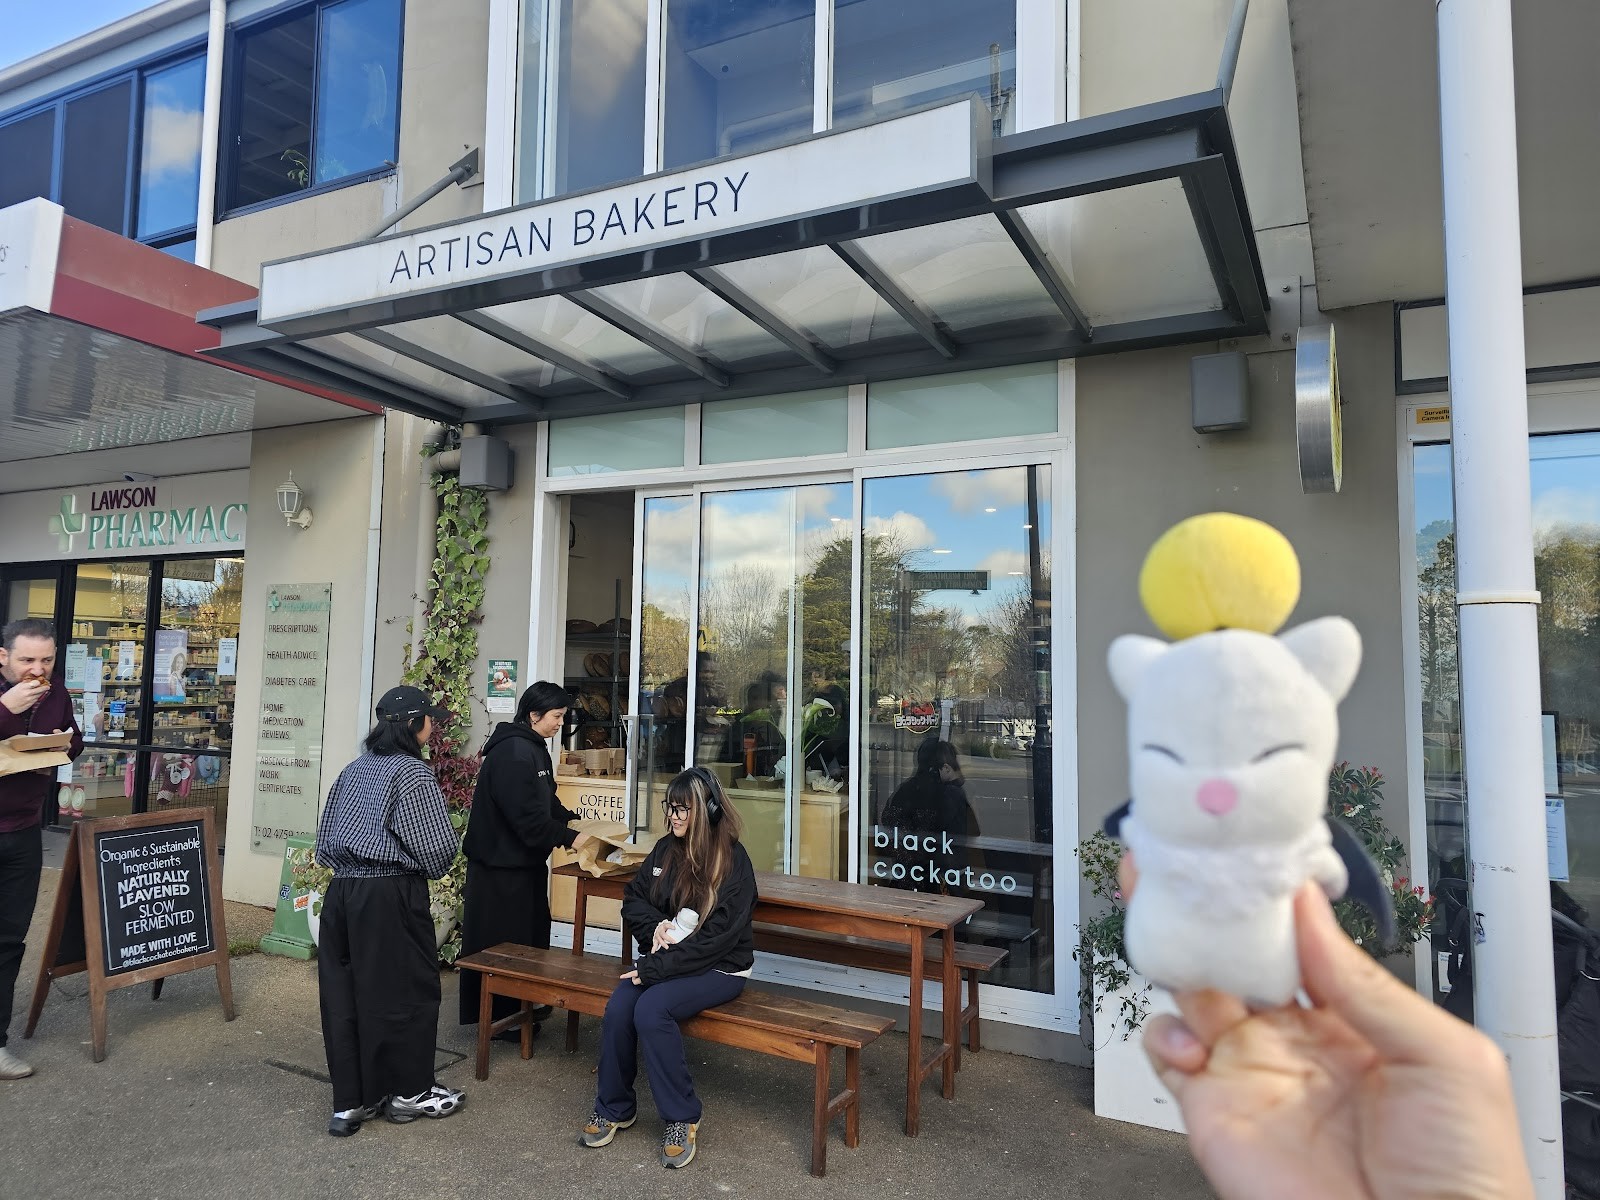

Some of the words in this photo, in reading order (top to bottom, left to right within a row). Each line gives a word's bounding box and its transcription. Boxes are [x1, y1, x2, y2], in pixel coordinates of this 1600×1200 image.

[390, 217, 552, 283] ARTISAN
[573, 171, 750, 247] BAKERY
[90, 486, 156, 511] LAWSON
[87, 503, 248, 550] PHARMAC
[268, 624, 318, 633] PRESCRIPTIONS
[267, 651, 292, 660] HEALTH
[293, 651, 317, 660] ADVICE
[265, 676, 296, 686] DIABETES
[298, 677, 316, 686] CARE
[263, 703, 284, 713] HOME
[262, 716, 304, 727] MEDICATION
[261, 729, 290, 740] REVIEWS
[259, 756, 289, 767] ABSENCE
[290, 758, 310, 768] FROM
[259, 770, 280, 779] WORK
[258, 782, 302, 795] CERTIFICATES
[580, 794, 623, 809] COFFEE
[576, 806, 601, 820] PICK
[610, 810, 626, 823] UP
[253, 825, 261, 837] T:
[262, 827, 272, 838] 02
[873, 824, 954, 855] black
[100, 847, 140, 864] Organic
[150, 837, 201, 855] Sustainable
[122, 856, 181, 875] Ingredients
[117, 869, 190, 895] NATURALLY
[873, 859, 1017, 893] cockatoo
[119, 884, 191, 909] LEAVENED
[138, 898, 175, 919] SLOW
[125, 909, 195, 937] FERMENTED
[120, 943, 147, 959] MADE
[148, 937, 172, 952] WITH
[173, 931, 198, 944] LOVE
[122, 945, 199, 968] @blackcockatoobakery
